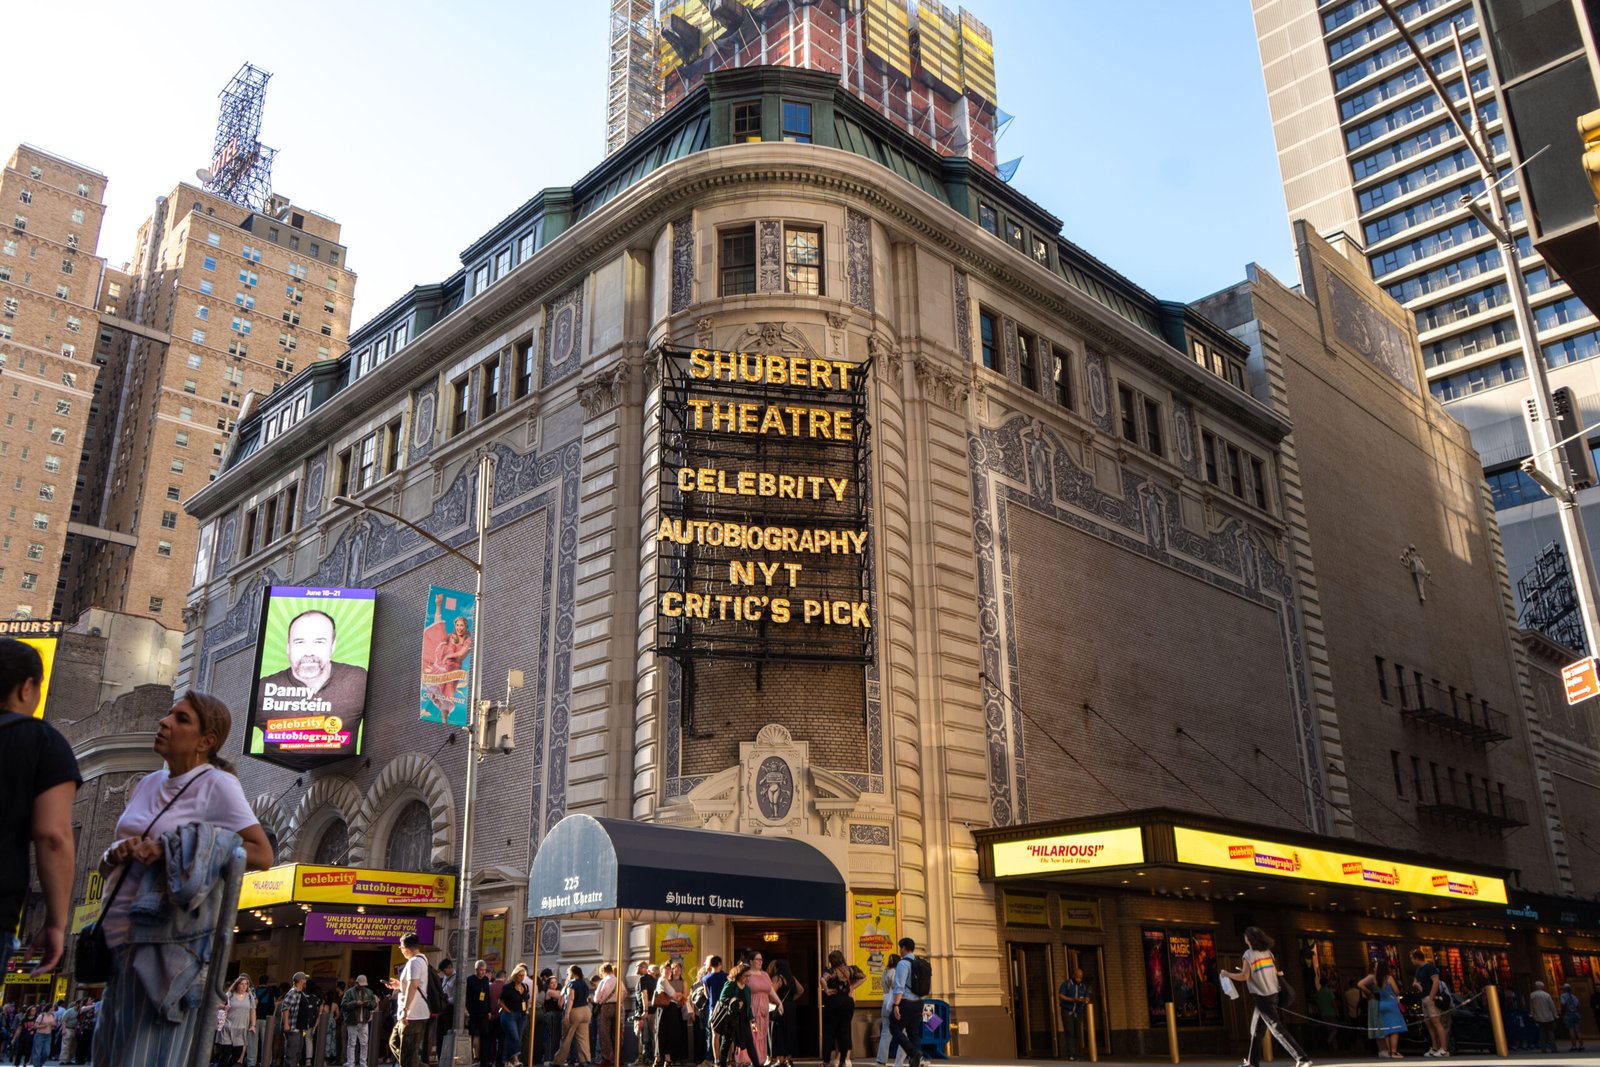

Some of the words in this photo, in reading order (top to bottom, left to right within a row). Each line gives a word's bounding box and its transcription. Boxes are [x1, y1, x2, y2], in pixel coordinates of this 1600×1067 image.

[689, 348, 854, 390] SHUBERT
[687, 399, 853, 441] THEATRE
[677, 467, 849, 502] CELEBRITY
[657, 517, 869, 555] AUTOBIOGRAPHY
[730, 560, 802, 588] NYT
[662, 591, 791, 624] CRITIC'S
[804, 600, 871, 628] PICK
[0, 621, 62, 633] DHURST
[264, 682, 316, 699] Danny
[262, 697, 332, 711] Burstein
[269, 718, 324, 730] celebrity
[267, 731, 348, 743] autobiography
[1026, 844, 1104, 857] “HILARIOUS!”
[1230, 847, 1254, 858] celebrity
[1255, 856, 1293, 870] autobiography
[304, 873, 354, 884] celebrity
[356, 883, 432, 897] autobiography
[541, 895, 571, 910] Shubert
[573, 891, 603, 906] Theatre
[665, 891, 705, 906] Shubert
[708, 893, 744, 909] Theatre
[323, 915, 351, 923] “UNLESS
[1170, 943, 1190, 954] MAGIC
